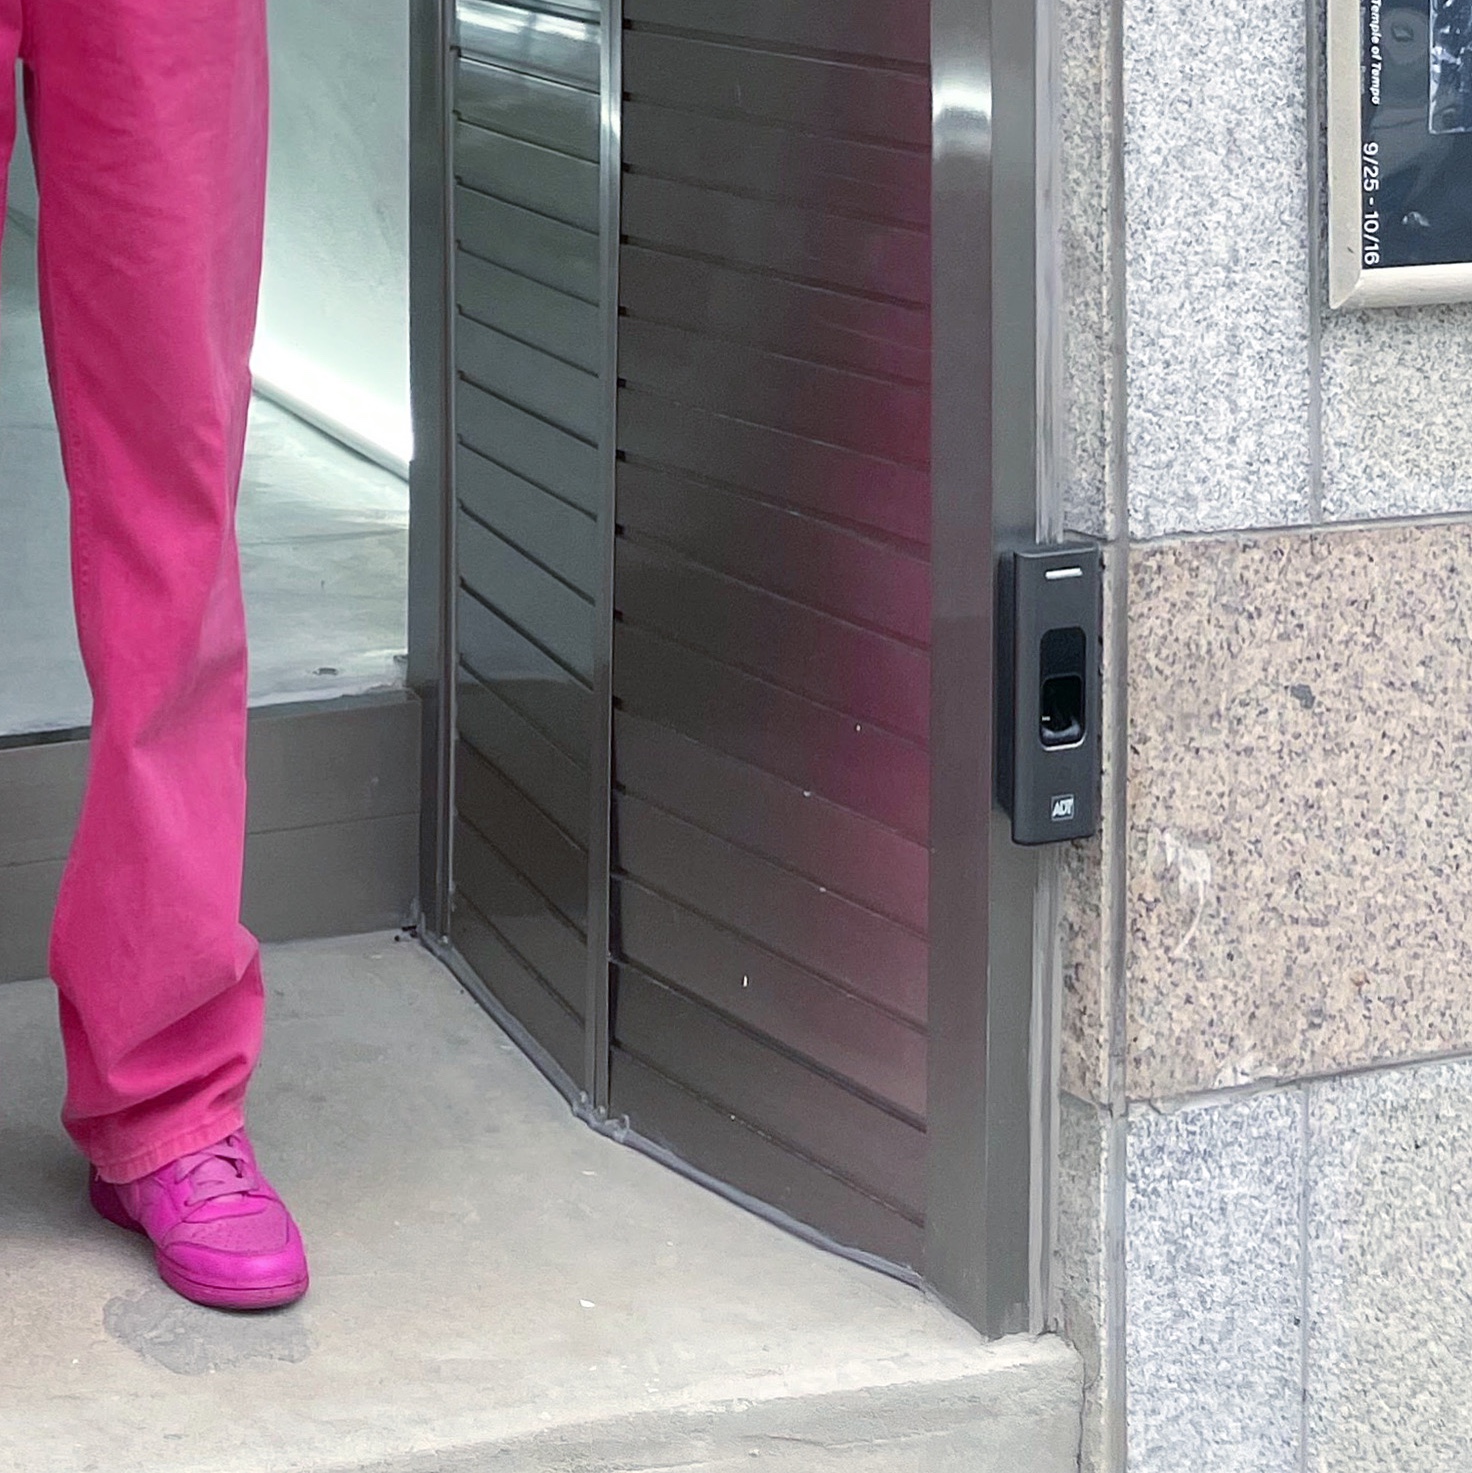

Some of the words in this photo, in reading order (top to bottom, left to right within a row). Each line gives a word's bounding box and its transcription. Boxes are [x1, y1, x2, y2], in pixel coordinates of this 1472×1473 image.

[1371, 46, 1382, 60] of
[1371, 62, 1382, 105] Tempo
[1363, 142, 1379, 192] 9/25
[1363, 210, 1380, 265] 10/16
[1052, 798, 1074, 817] ADT
